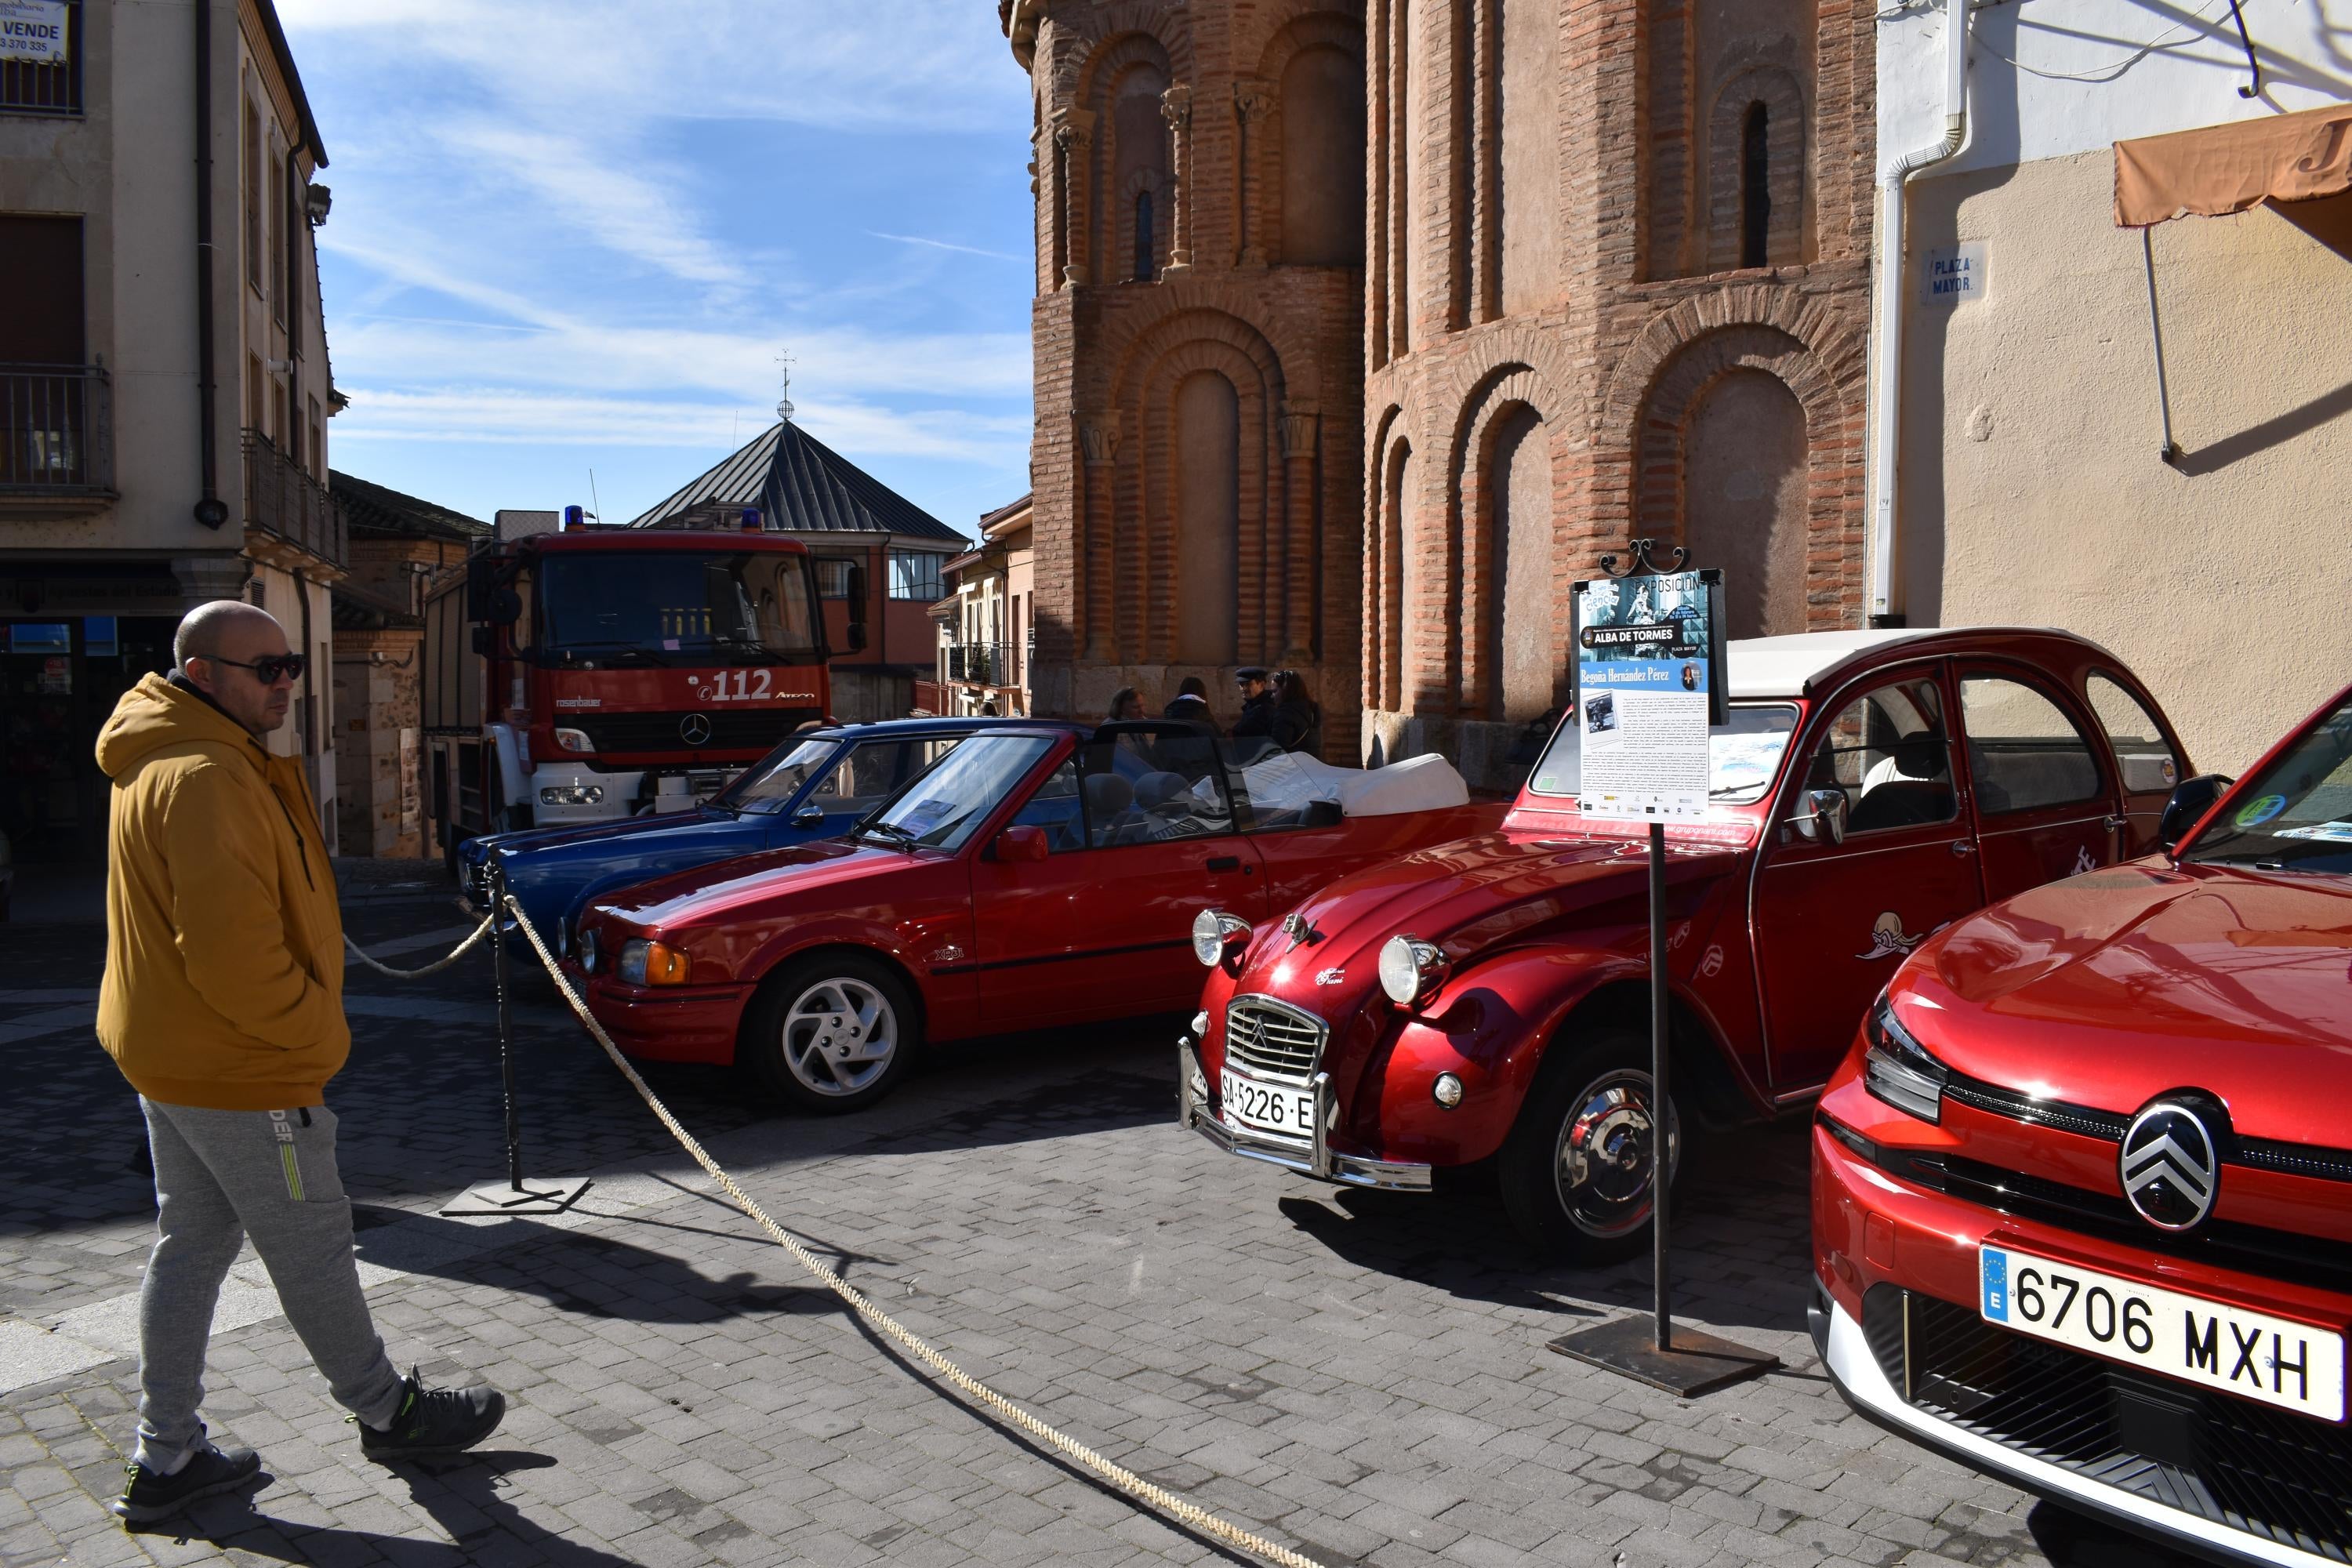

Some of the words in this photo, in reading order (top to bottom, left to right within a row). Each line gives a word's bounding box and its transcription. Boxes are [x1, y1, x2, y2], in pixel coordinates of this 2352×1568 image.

[3, 20, 60, 39] VENDE
[9, 38, 27, 49] 370
[30, 41, 47, 52] 335
[1935, 257, 1970, 275] PLAZA
[136, 584, 178, 597] Estado
[1594, 633, 1618, 644] ALBA
[1619, 632, 1632, 641] DE
[1633, 630, 1673, 641] TORMES
[1581, 670, 1606, 684] Begoña
[1608, 668, 1646, 682] Hernández
[1647, 666, 1669, 681] Pérez
[712, 669, 771, 702] 112
[556, 695, 601, 707] rosenbauer
[1991, 1291, 2001, 1309] E
[2016, 1267, 2154, 1354] 6706
[2185, 1310, 2307, 1401] MXH
